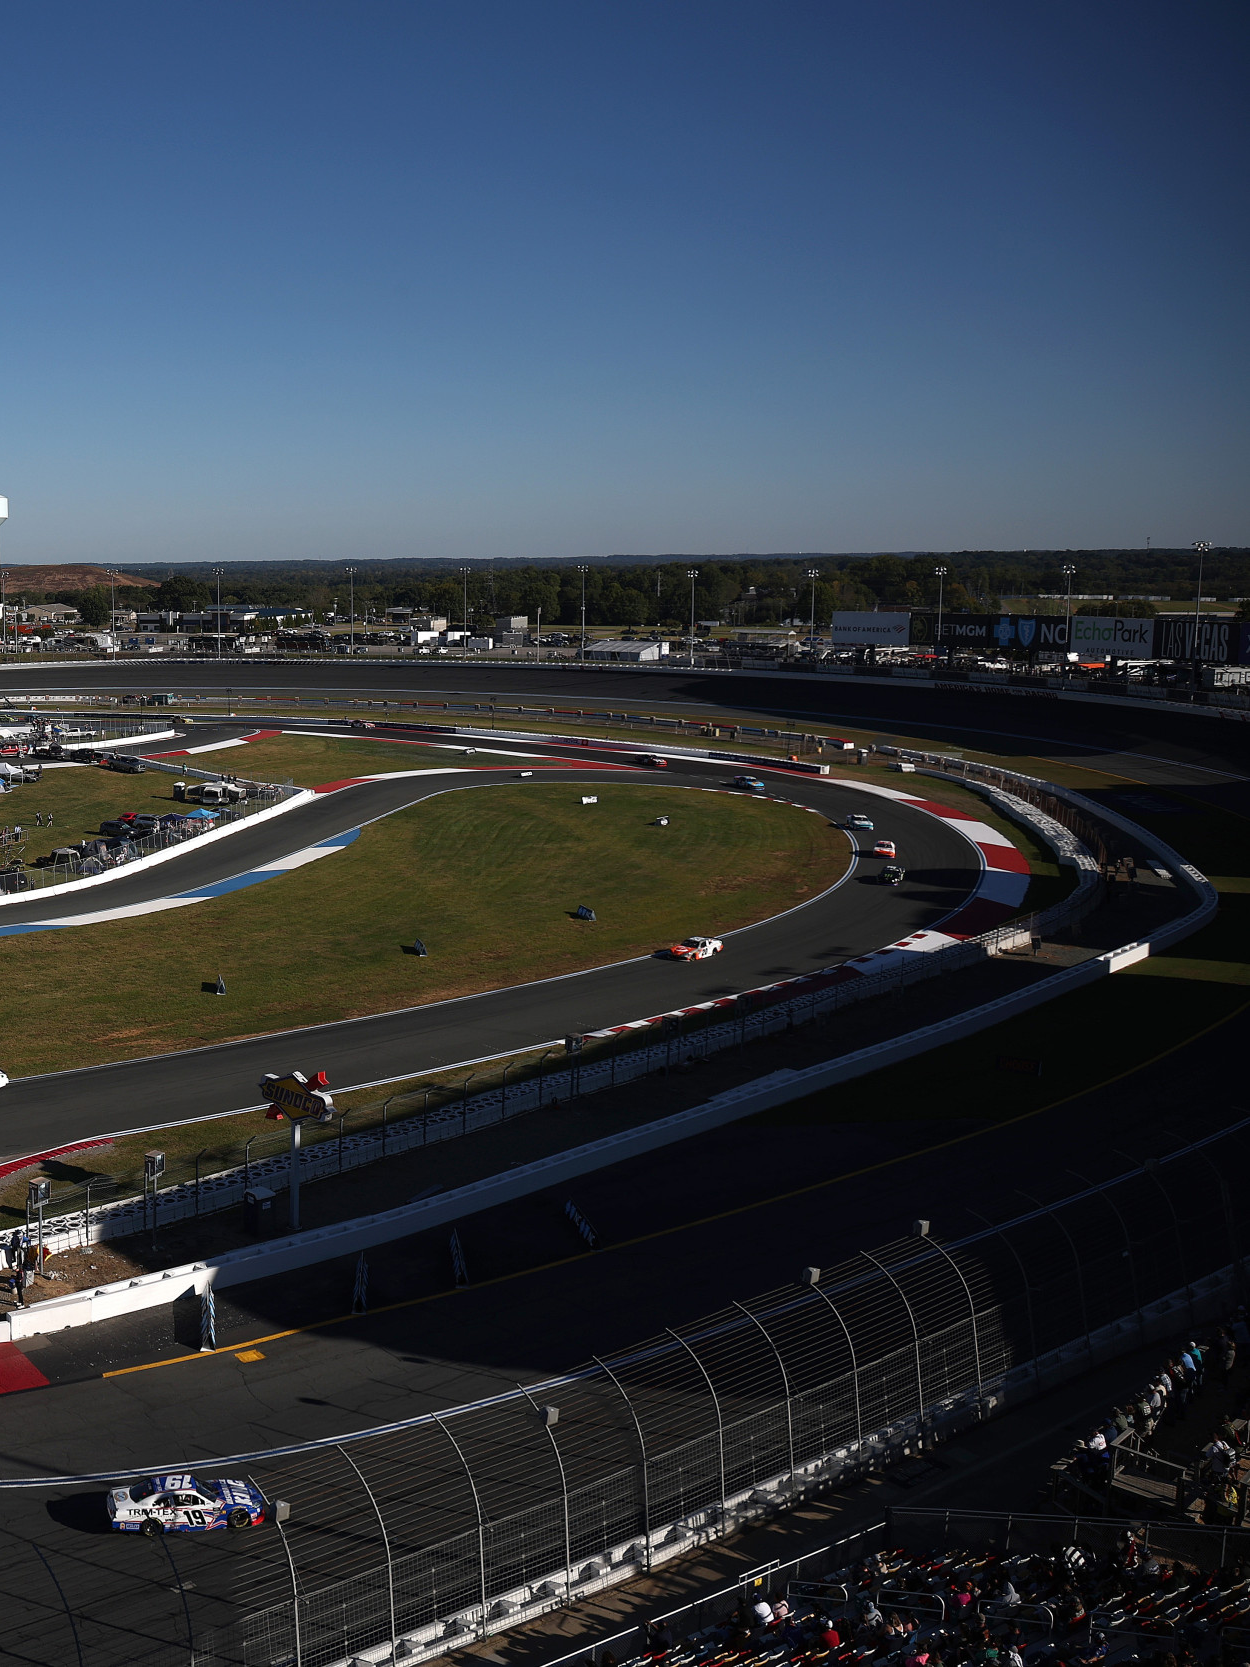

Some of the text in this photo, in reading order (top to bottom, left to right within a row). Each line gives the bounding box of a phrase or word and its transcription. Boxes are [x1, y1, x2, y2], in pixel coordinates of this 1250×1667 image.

[934, 623, 986, 637] BETMGM
[1040, 623, 1067, 645] NC
[1074, 619, 1149, 645] EchoPark
[1161, 622, 1229, 662] LAS VEGAS
[1086, 647, 1134, 656] AUTOMOTIVE
[263, 1083, 322, 1116] SUNOCO
[164, 1474, 193, 1490] 19
[126, 1508, 177, 1516] TRIM-TEX
[183, 1509, 207, 1527] 19
